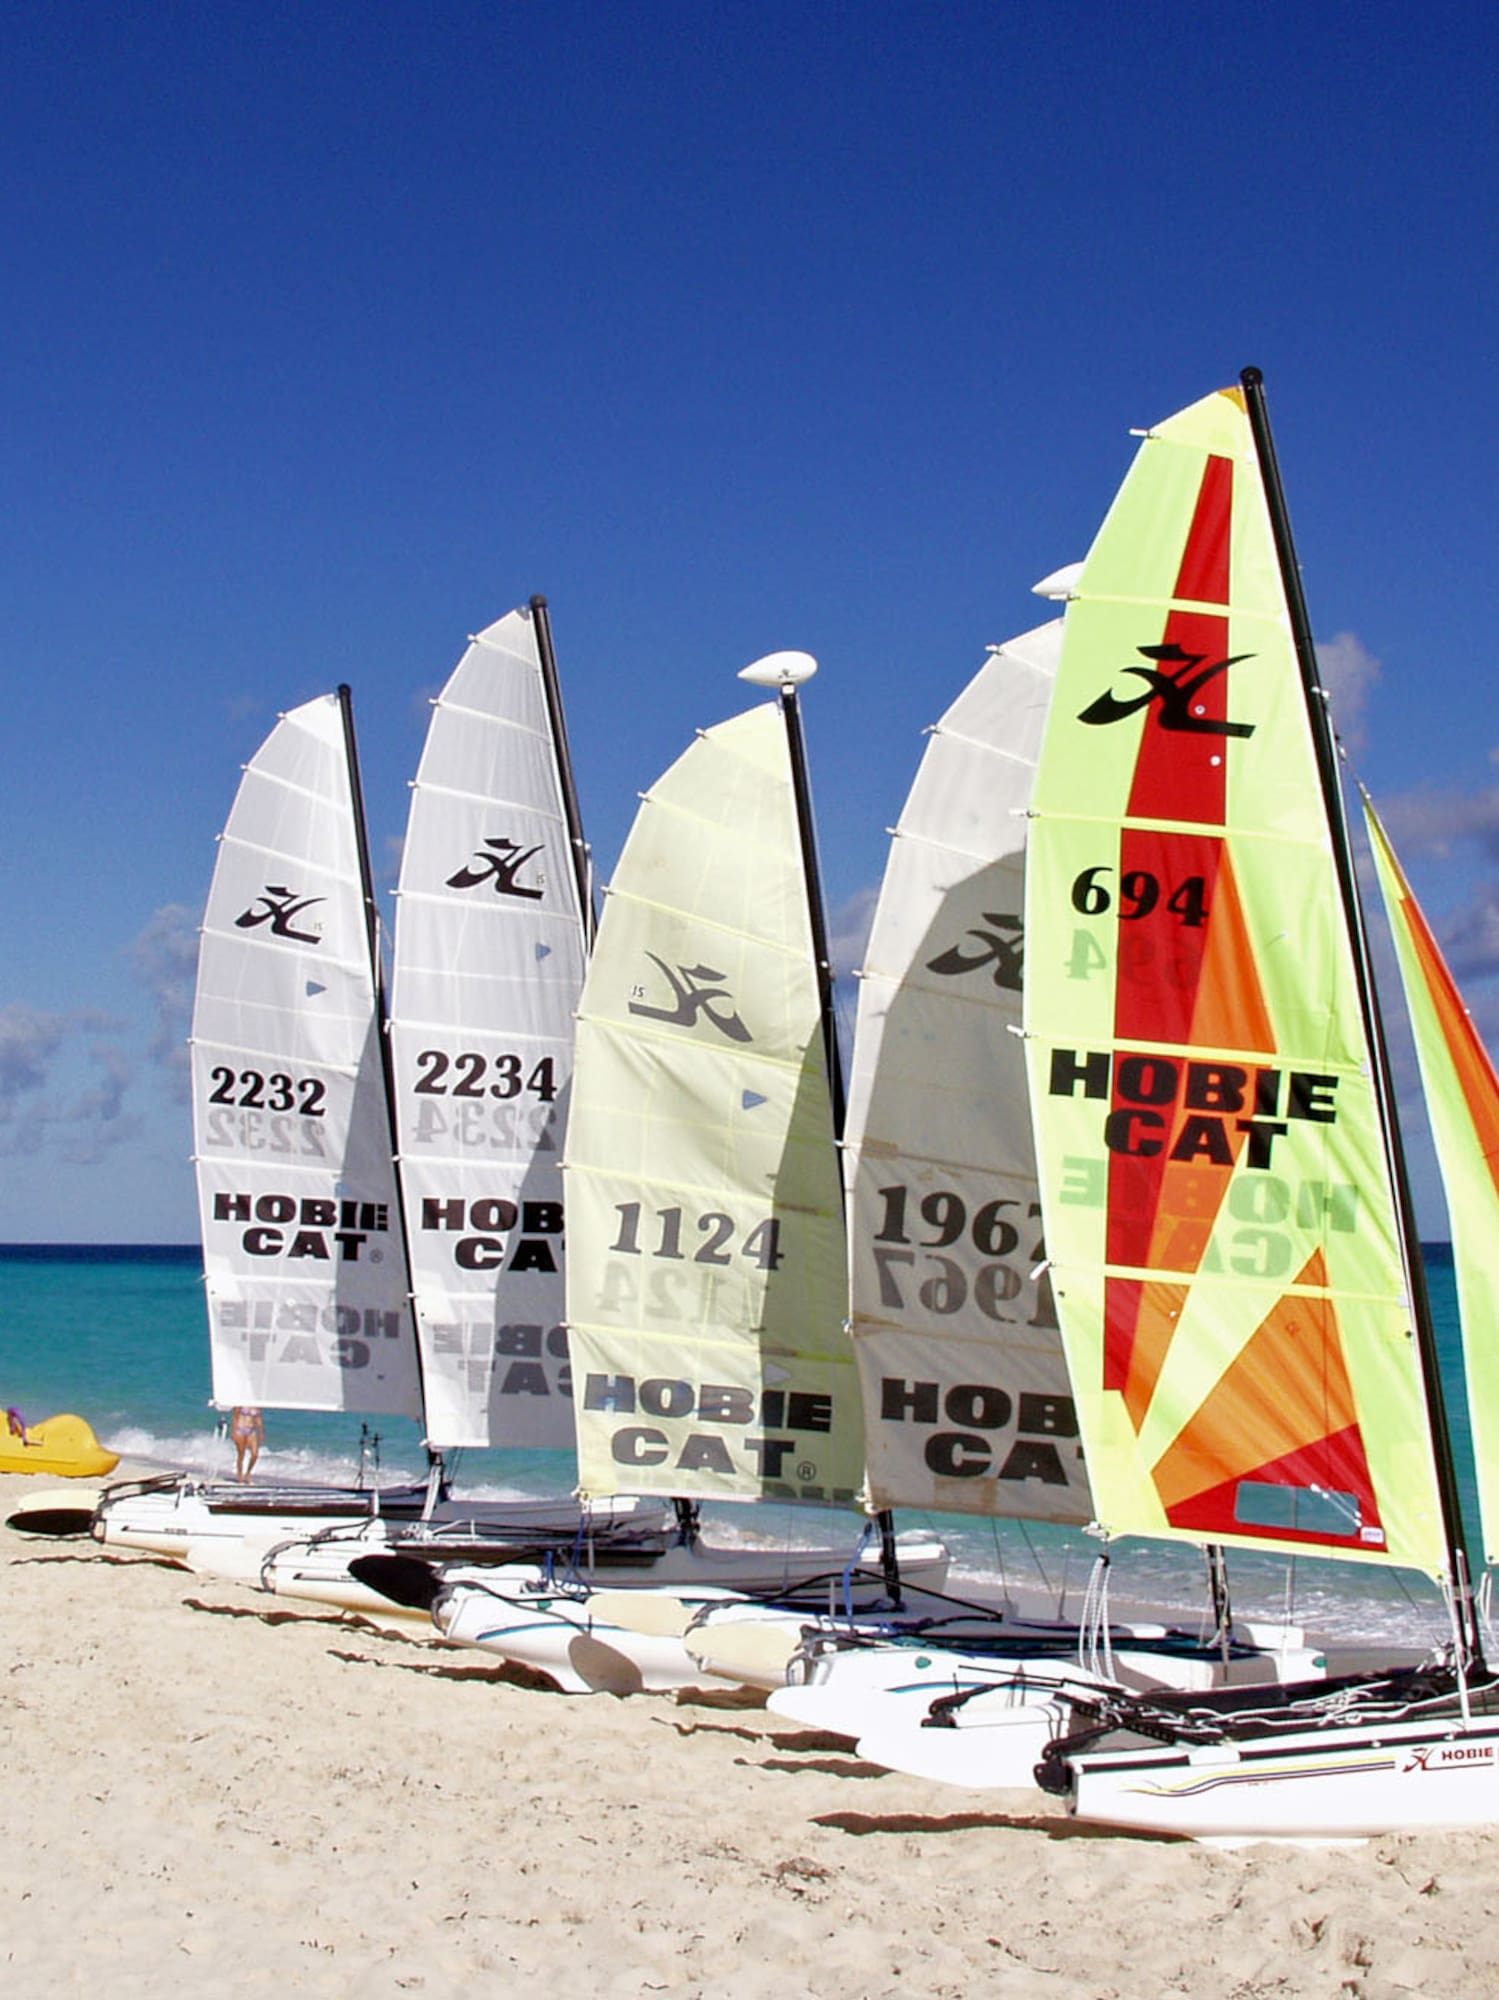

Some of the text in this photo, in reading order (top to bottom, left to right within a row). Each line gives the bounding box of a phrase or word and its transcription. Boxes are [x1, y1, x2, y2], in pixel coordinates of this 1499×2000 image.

[1072, 866, 1209, 928] 694
[209, 1066, 326, 1118] 2232
[414, 1050, 557, 1103] 2234
[1049, 1047, 1339, 1124] HOBIE
[1104, 1108, 1288, 1170] CAT
[214, 1192, 388, 1232] HOBIE
[609, 1202, 784, 1271] 1124
[243, 1226, 367, 1262] CAT
[455, 1236, 565, 1273] CA
[584, 1372, 832, 1434] HOBIE
[611, 1426, 796, 1478] CAT
[924, 1431, 1084, 1486] CA
[1441, 1747, 1493, 1761] HOBIE
